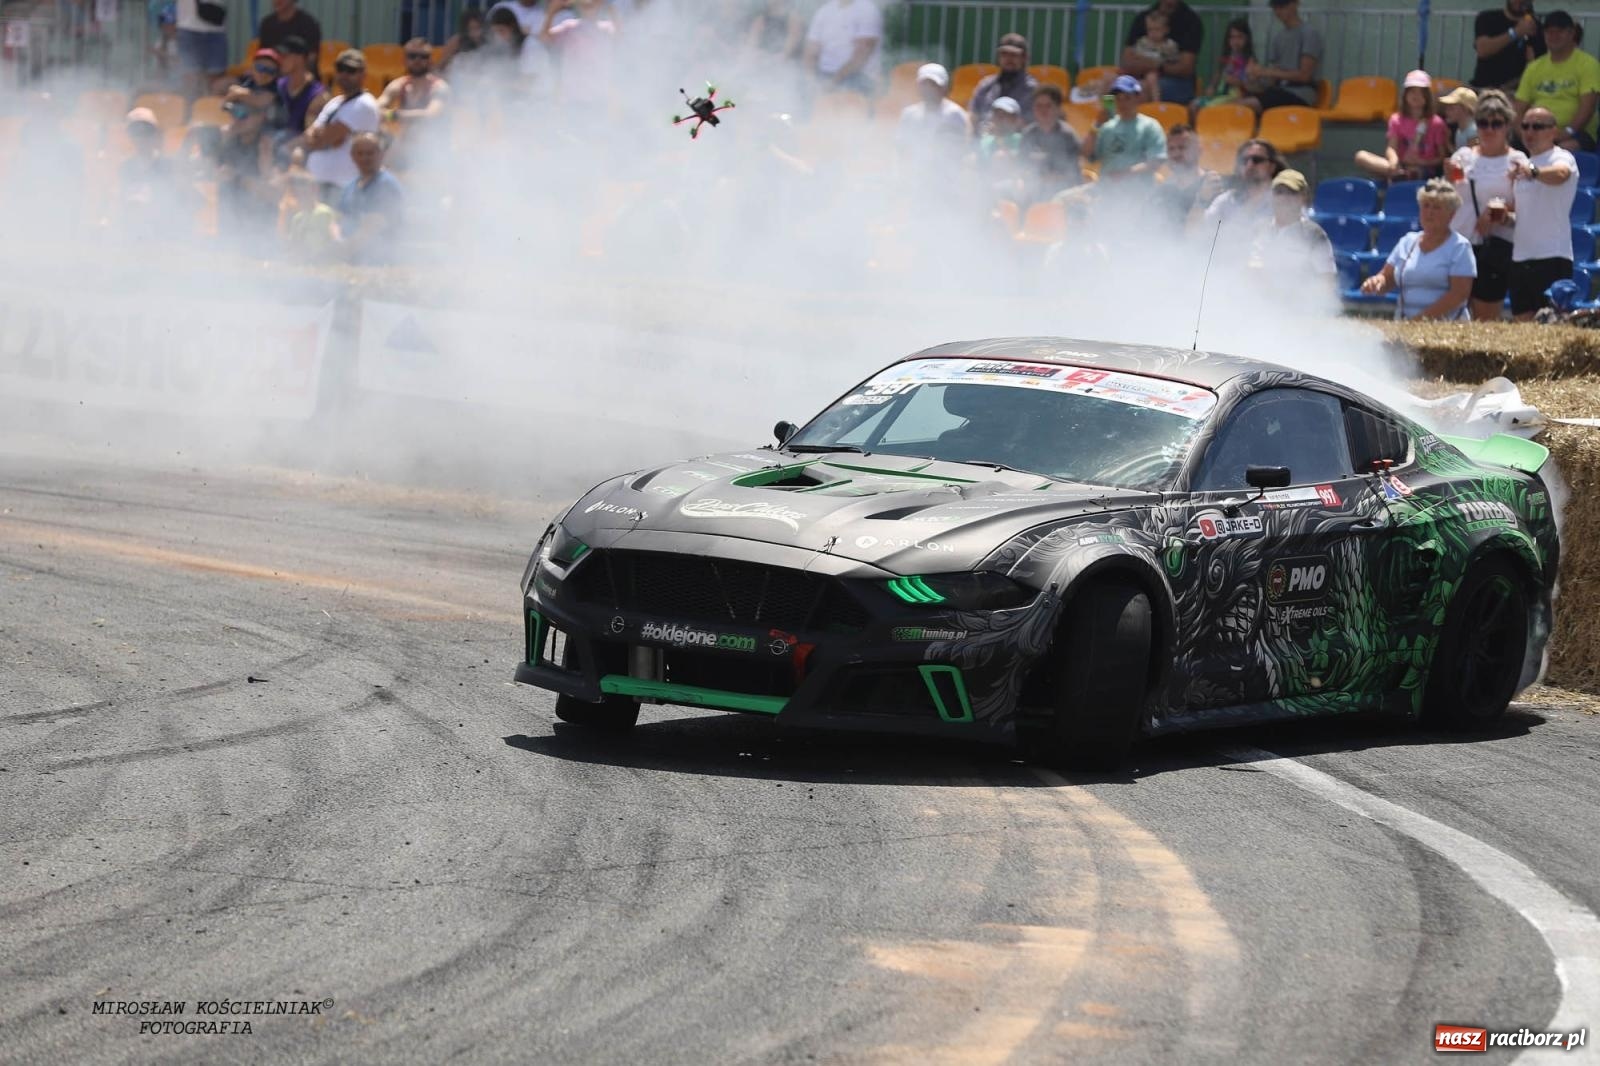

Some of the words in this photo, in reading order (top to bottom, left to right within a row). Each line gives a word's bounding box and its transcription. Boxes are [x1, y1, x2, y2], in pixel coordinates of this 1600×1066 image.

[1319, 488, 1337, 505] 997
[884, 537, 954, 553] ARLON
[1287, 564, 1326, 592] PMO
[1313, 606, 1328, 617] OILS
[641, 623, 756, 650] #oklejone.com
